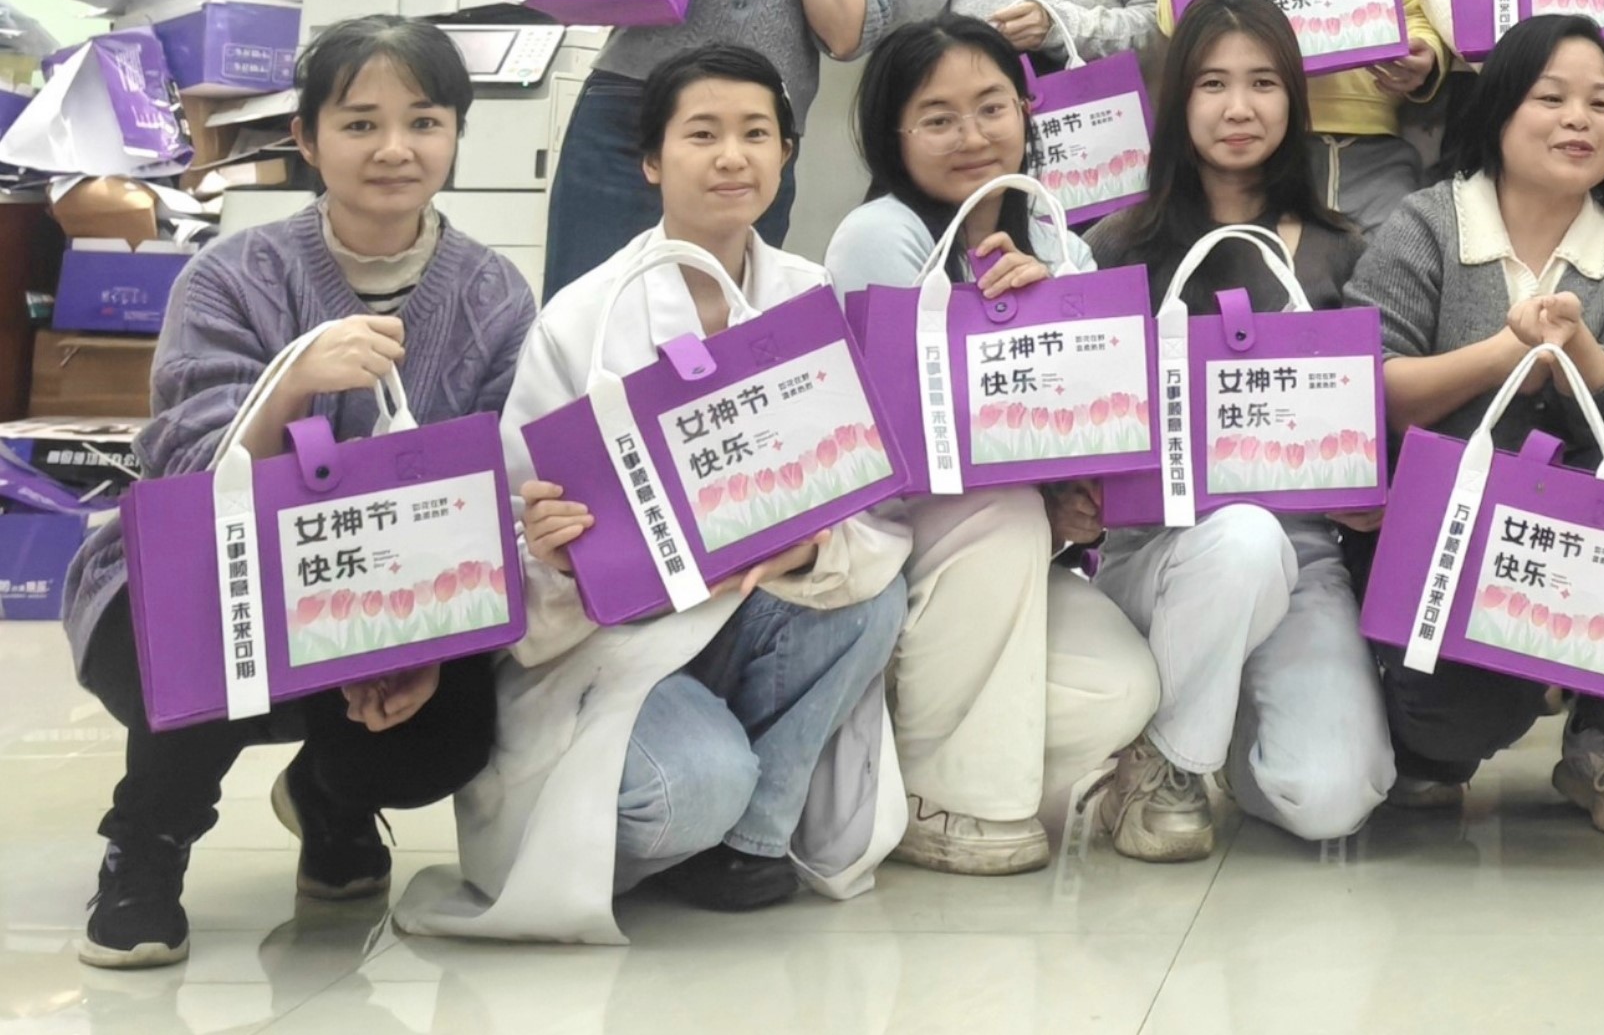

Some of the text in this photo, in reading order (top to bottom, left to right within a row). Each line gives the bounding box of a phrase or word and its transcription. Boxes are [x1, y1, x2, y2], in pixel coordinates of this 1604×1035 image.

[980, 332, 1063, 364] 女神节
[980, 368, 1037, 396] 快乐
[1218, 367, 1297, 394] 女神节
[676, 385, 768, 444] 女神节
[1218, 403, 1270, 429] 快乐
[689, 432, 753, 479] 快乐
[294, 500, 397, 546] 女神节
[615, 433, 685, 576] 万事顺意 未来可期
[1501, 516, 1584, 558] 女神节
[298, 546, 367, 587] 快乐
[1418, 504, 1471, 640] 万事顺意 未来可期
[1493, 552, 1547, 588] 快乐
[226, 523, 256, 680] 万事顺意 未来可期
